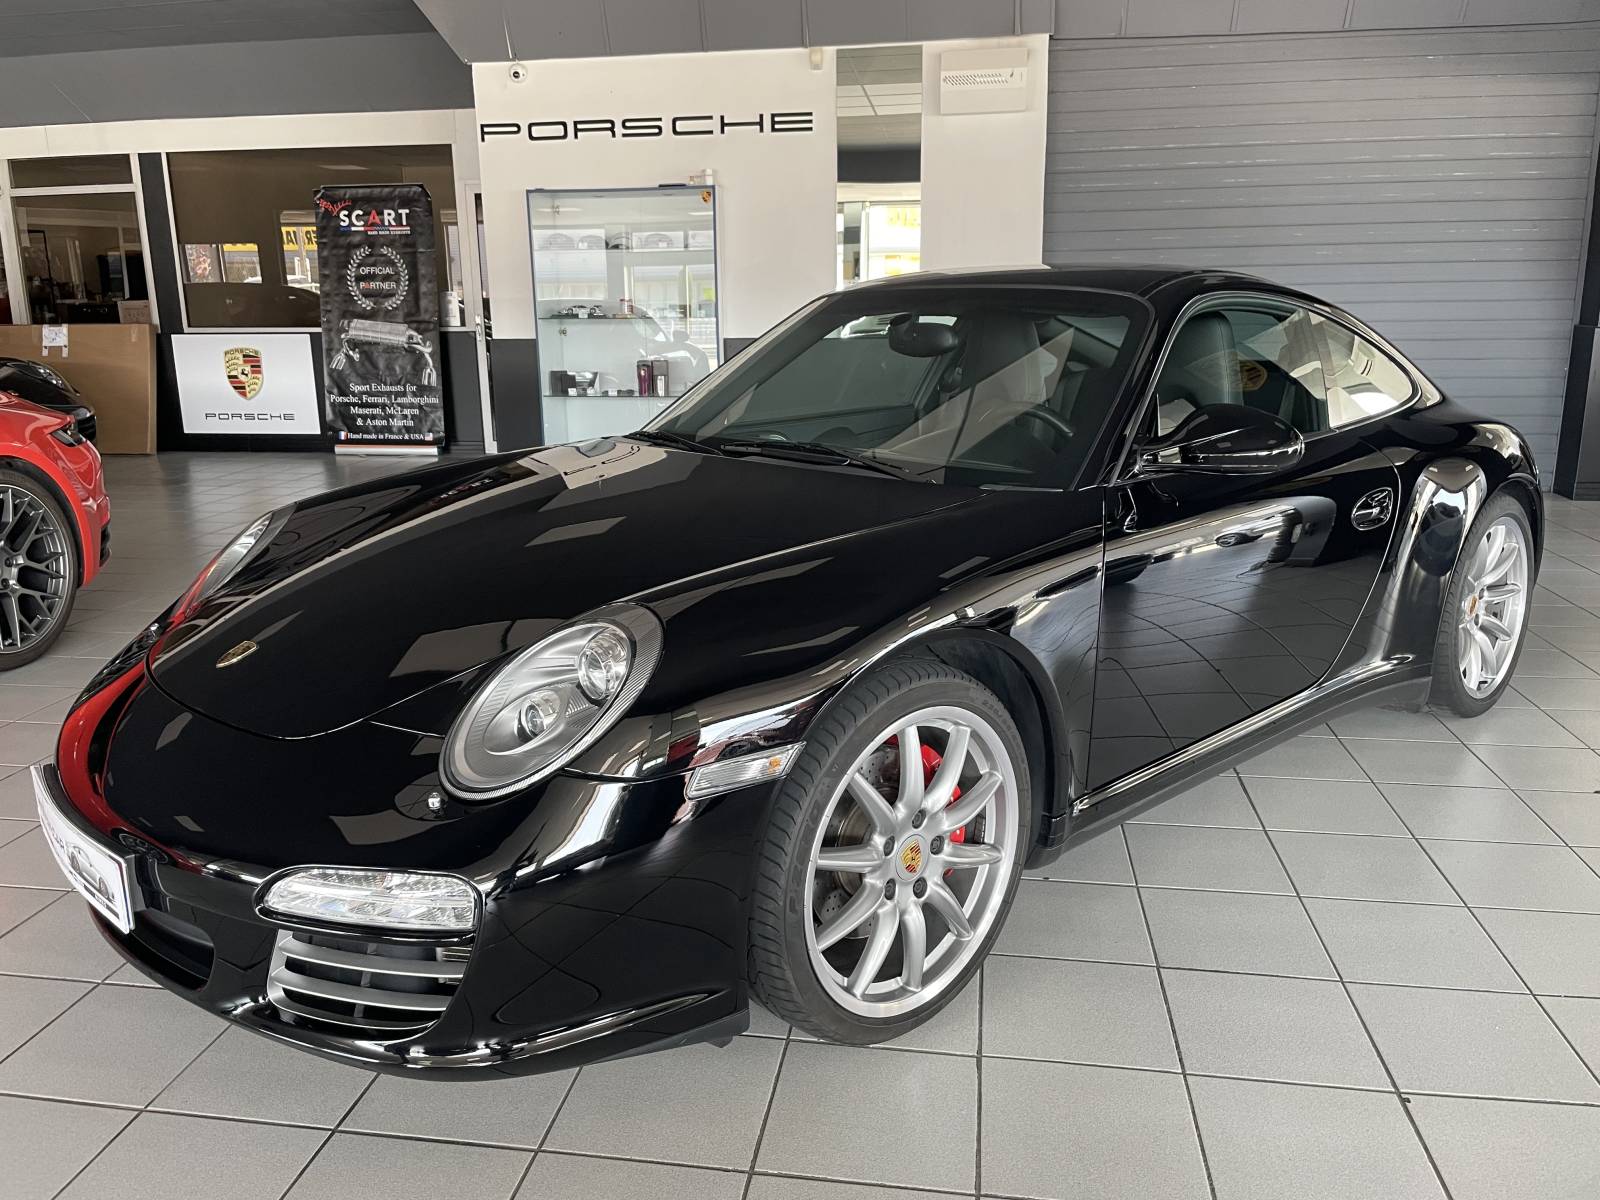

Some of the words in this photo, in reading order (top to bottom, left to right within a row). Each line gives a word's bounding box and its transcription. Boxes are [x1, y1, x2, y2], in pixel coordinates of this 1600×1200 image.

[480, 111, 814, 142] PORSCHE
[339, 208, 410, 227] SCART
[359, 266, 395, 275] OFFICIAL
[359, 281, 397, 290] PARTNER
[224, 347, 262, 356] PORSCHE
[349, 383, 370, 393] Sport
[372, 383, 404, 391] Exhausts
[406, 383, 417, 391] for
[330, 395, 361, 404] Porsche,
[362, 395, 390, 404] Ferrari,
[391, 395, 439, 405] Lamborghini
[350, 406, 384, 415] Maserati,
[386, 407, 419, 415] McLaren
[204, 412, 295, 421] PORSCHE
[356, 418, 363, 426] &
[365, 418, 388, 426] Aston
[389, 418, 414, 426] Martin
